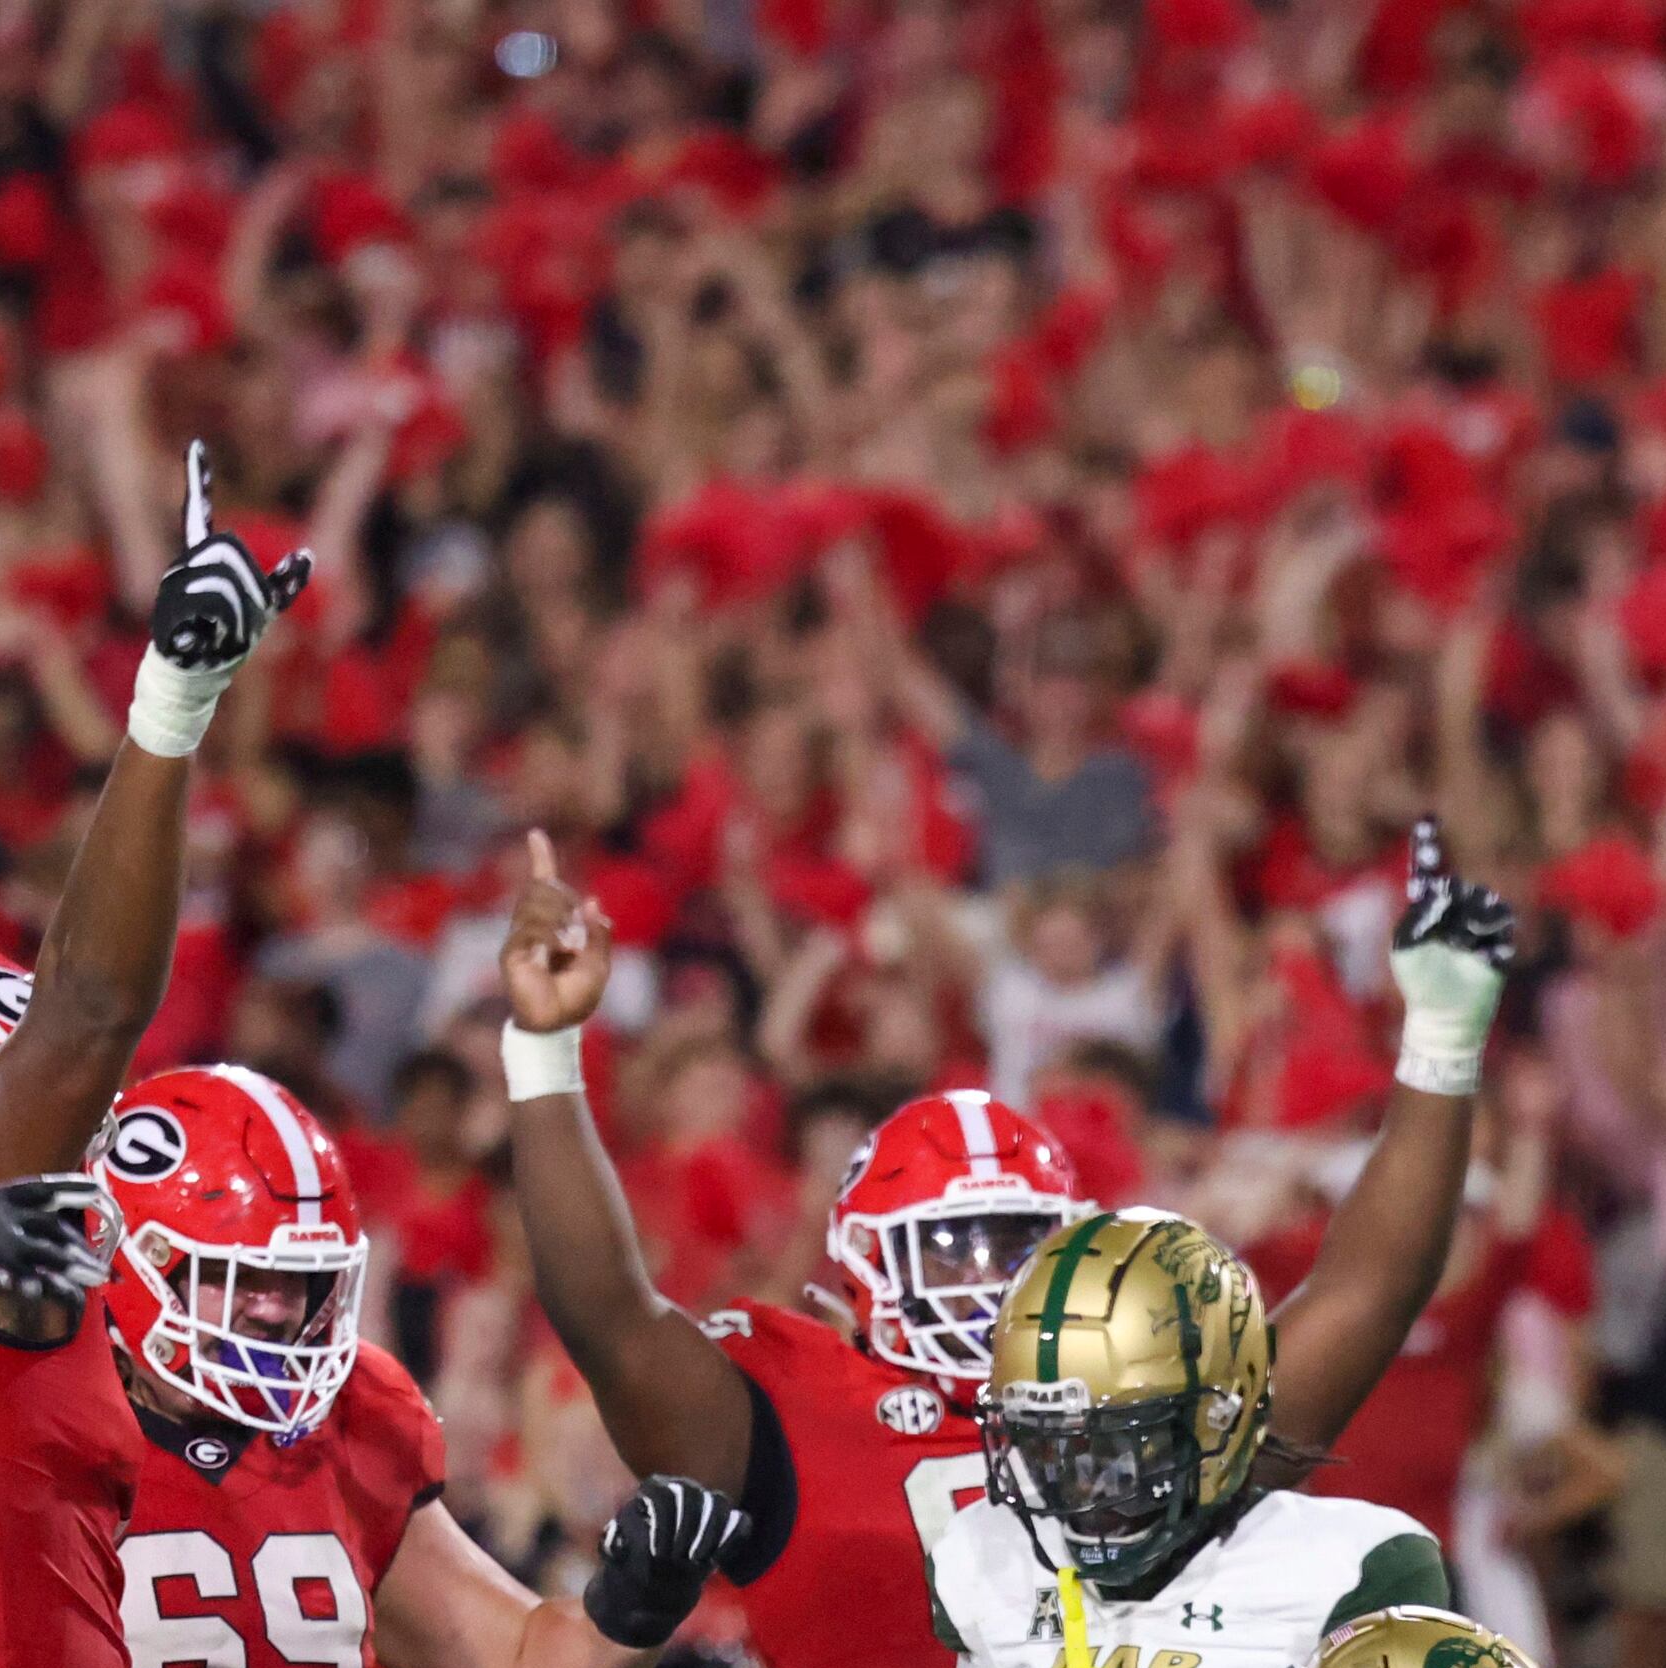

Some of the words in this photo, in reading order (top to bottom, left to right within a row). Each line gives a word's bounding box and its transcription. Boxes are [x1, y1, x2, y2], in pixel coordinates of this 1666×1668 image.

[109, 1109, 185, 1181] G
[876, 1386, 945, 1435] SEC
[186, 1438, 229, 1468] G
